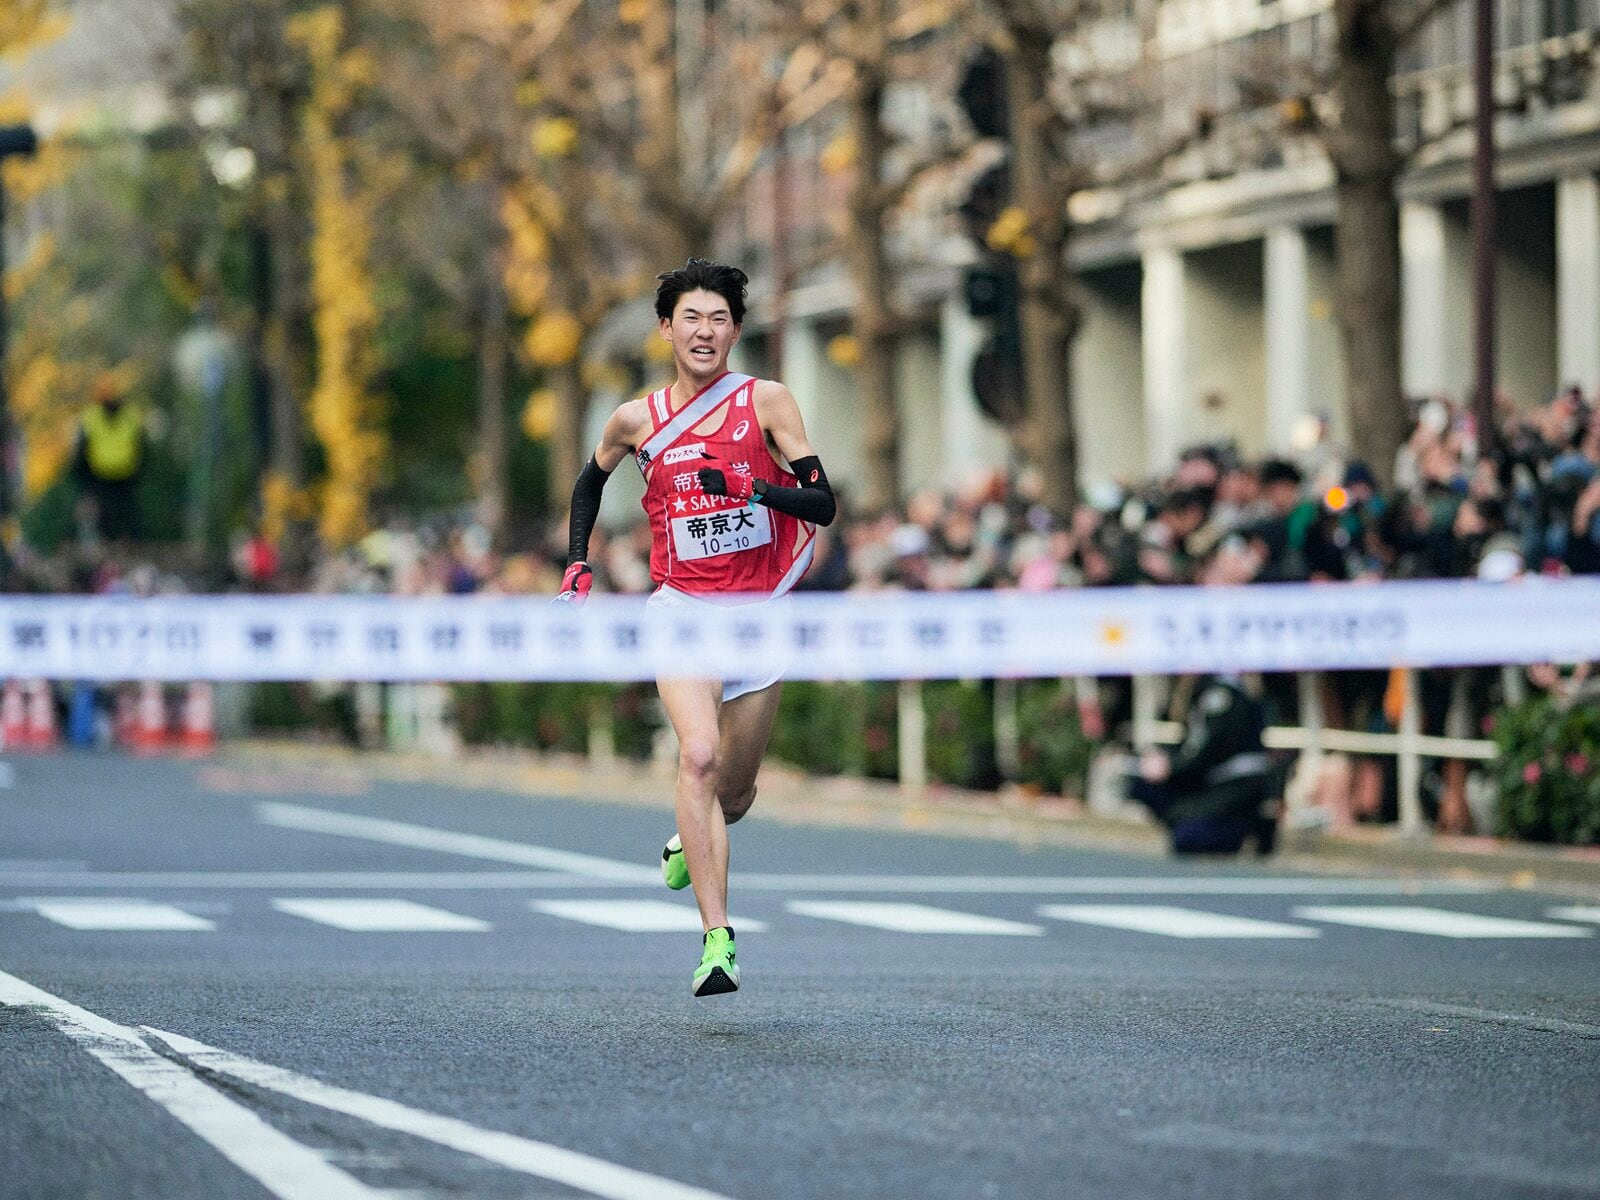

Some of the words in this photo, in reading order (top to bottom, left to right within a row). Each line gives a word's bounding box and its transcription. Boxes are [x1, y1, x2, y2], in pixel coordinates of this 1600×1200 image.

[686, 509, 755, 539] 帝京大
[700, 536, 750, 555] 10-10
